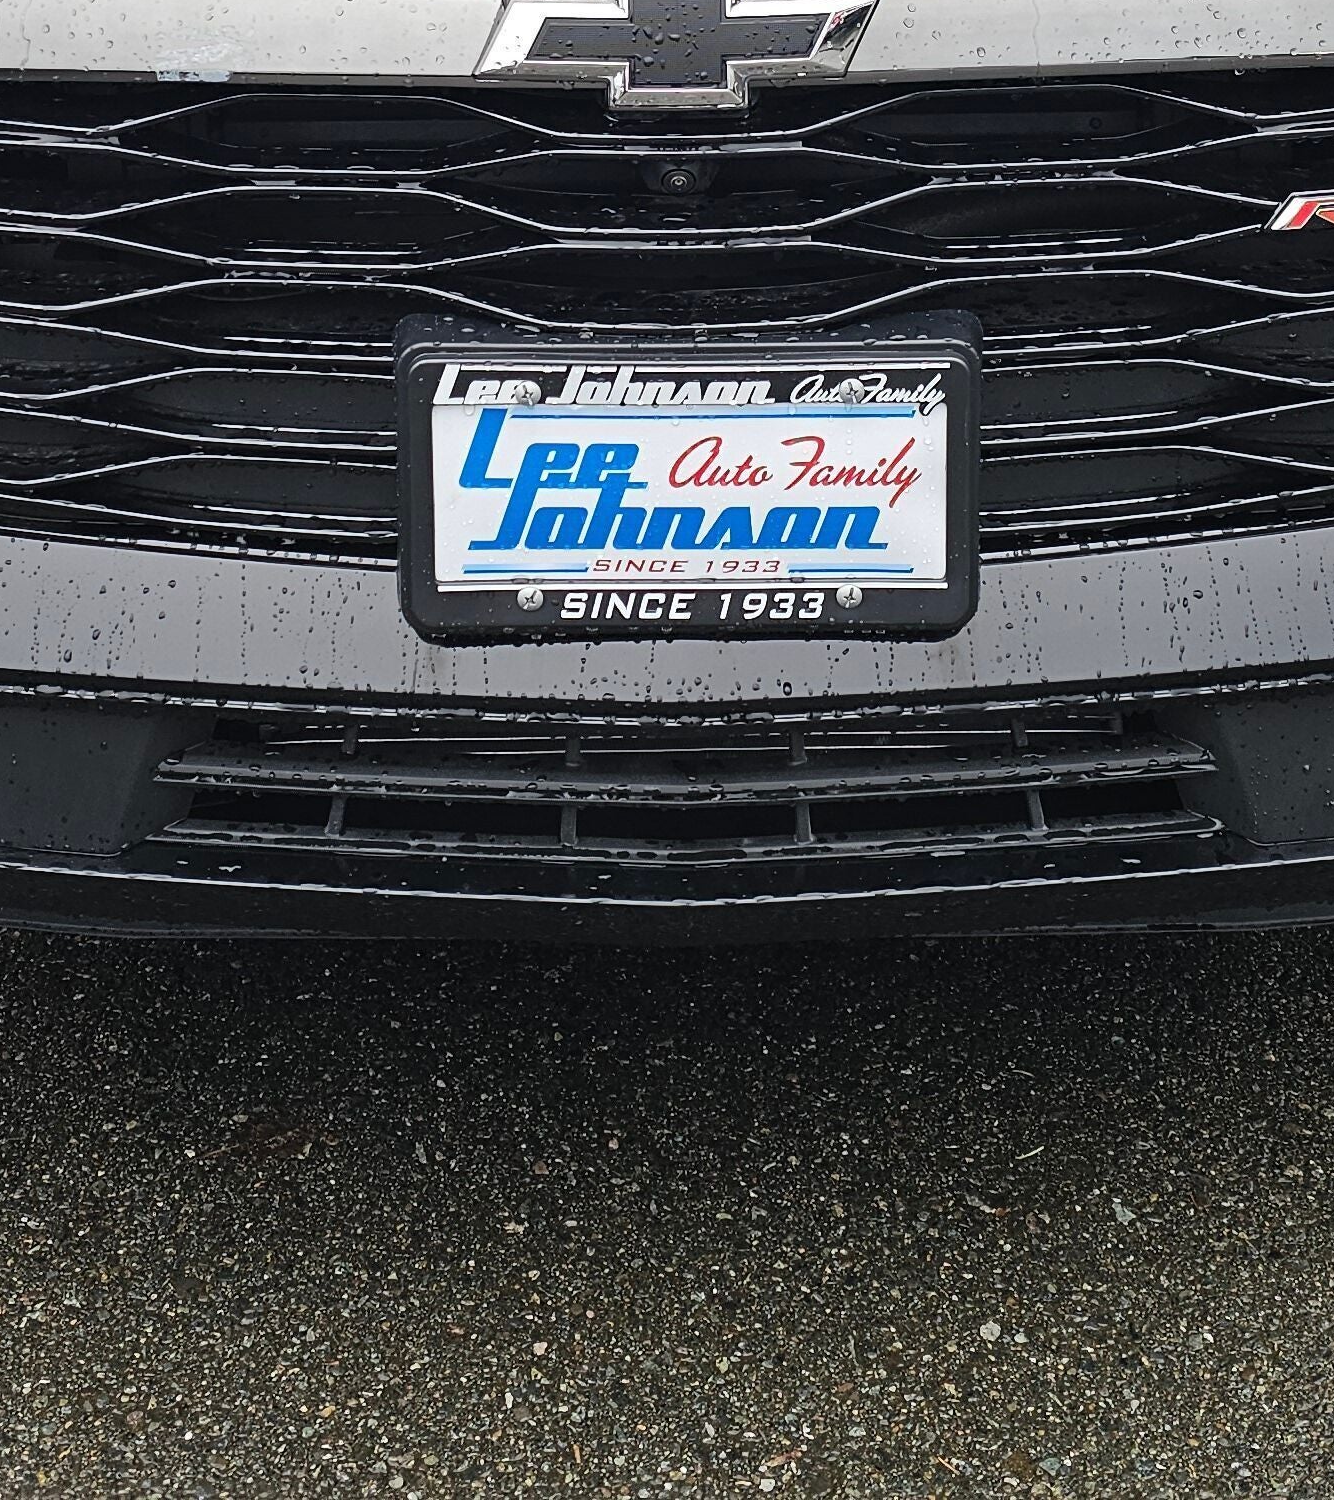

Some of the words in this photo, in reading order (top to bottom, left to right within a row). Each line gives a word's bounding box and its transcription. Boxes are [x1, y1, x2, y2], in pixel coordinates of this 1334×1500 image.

[545, 365, 775, 405] Johnson
[790, 374, 851, 404] Aut
[858, 372, 946, 415] Family
[459, 408, 649, 489] Lee
[669, 437, 774, 488] Auto
[781, 436, 922, 508] Family
[468, 485, 889, 551] Johnson
[593, 560, 689, 573] SINCE
[704, 560, 782, 573] 1933
[560, 592, 695, 620] SINCE
[719, 591, 824, 619] 1933
